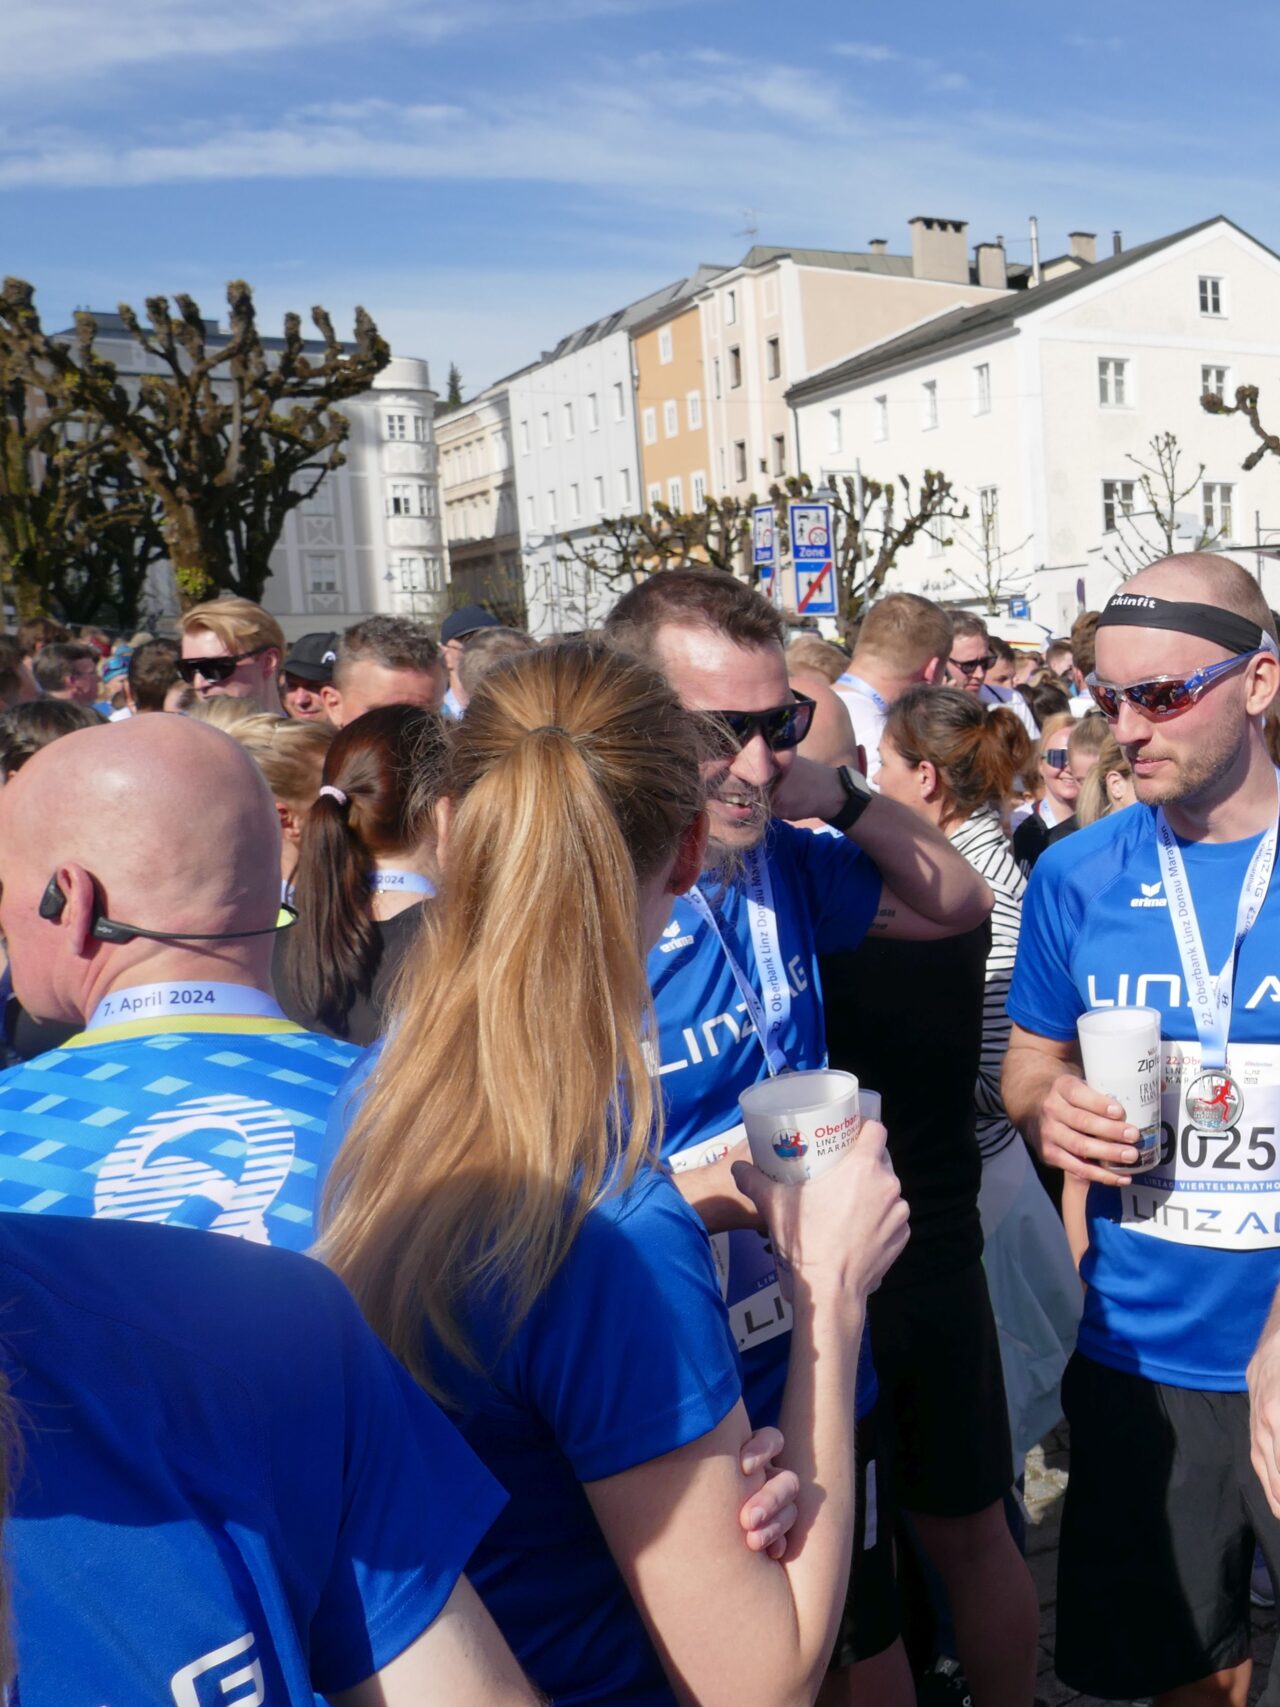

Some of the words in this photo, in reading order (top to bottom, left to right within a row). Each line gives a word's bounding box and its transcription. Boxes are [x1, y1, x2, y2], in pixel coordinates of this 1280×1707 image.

[799, 547, 826, 557] Zone
[1111, 596, 1156, 609] skinfit
[1161, 825, 1178, 877] Marathon
[377, 874, 405, 885] 2024
[1254, 879, 1268, 898] AG
[753, 889, 768, 928] Donau
[1130, 897, 1167, 908] erima
[1172, 880, 1189, 917] Donau
[660, 935, 694, 953] erima
[758, 931, 772, 954] Linz
[1183, 920, 1196, 945] Linz
[762, 956, 783, 1012] Oberbank
[788, 954, 809, 998] G
[1189, 947, 1209, 1005] Oberbank
[103, 1002, 116, 1017] 7.
[120, 990, 163, 1013] April
[169, 989, 216, 1005] 2024
[1088, 973, 1221, 1008] LIN
[1203, 1008, 1214, 1026] 22.
[1165, 1067, 1188, 1075] LINZ
[816, 1135, 837, 1148] LINZ
[1159, 1120, 1277, 1171] 9025
[1132, 1194, 1222, 1233] LINZ
[757, 1273, 776, 1288] LIN
[745, 1296, 785, 1334] LI
